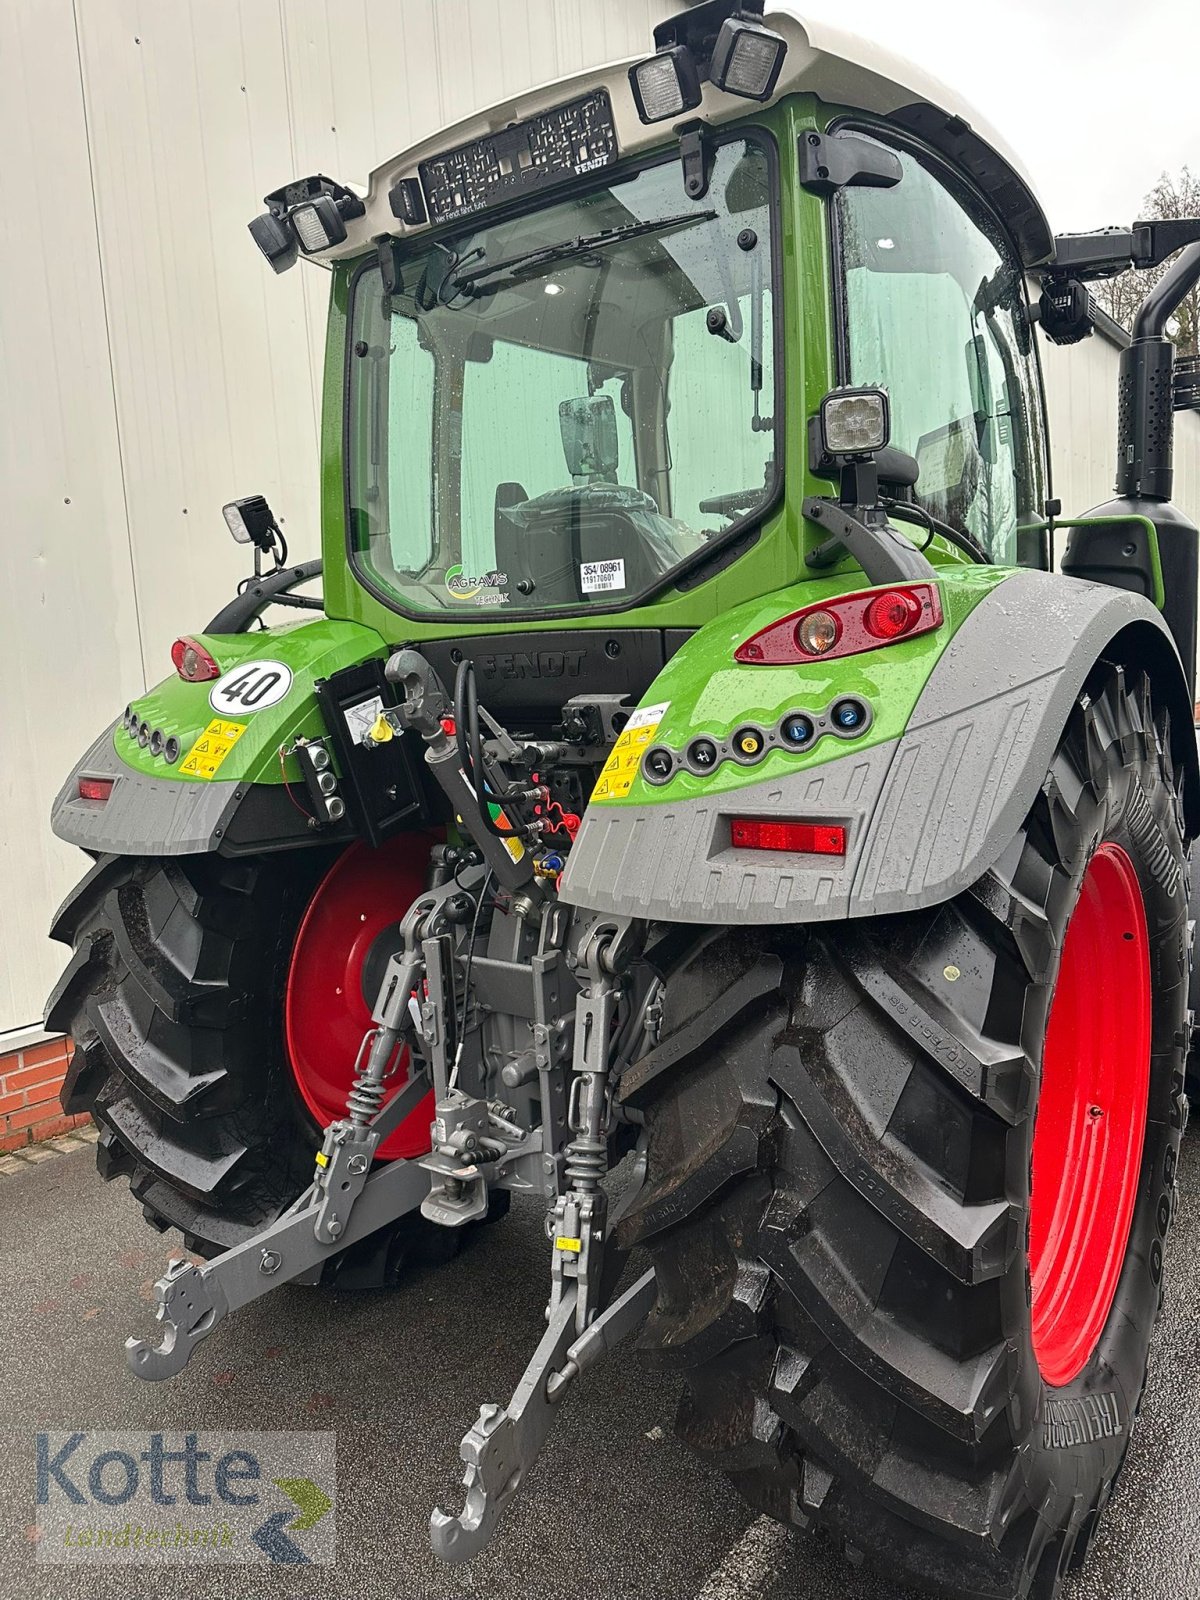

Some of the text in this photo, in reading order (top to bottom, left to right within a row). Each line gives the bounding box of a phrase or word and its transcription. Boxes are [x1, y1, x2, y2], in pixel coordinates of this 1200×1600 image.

[574, 154, 609, 175] FENDT
[450, 572, 509, 589] AGRAVIS
[476, 650, 588, 680] FENDT
[221, 667, 282, 706] 40
